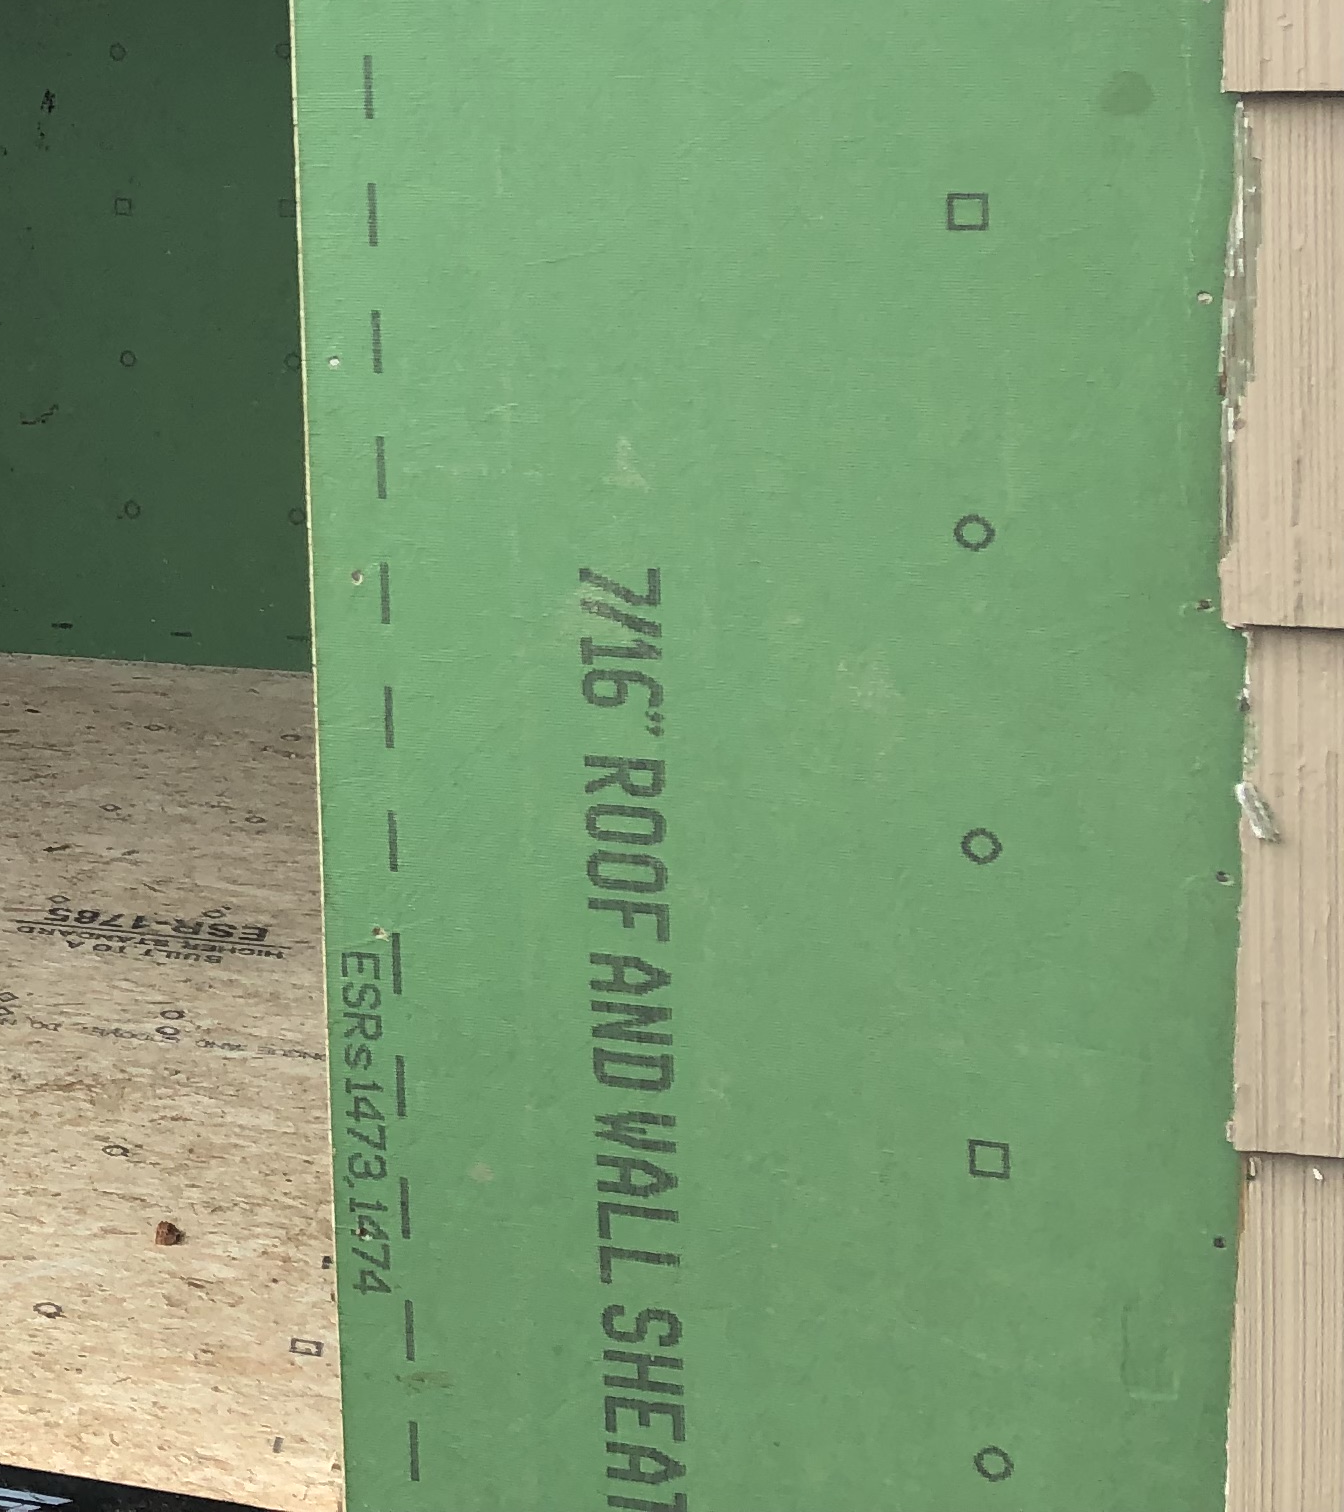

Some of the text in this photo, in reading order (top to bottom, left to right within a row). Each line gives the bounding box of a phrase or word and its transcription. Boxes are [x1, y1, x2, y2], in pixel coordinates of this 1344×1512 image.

[584, 753, 671, 943] ROOF
[43, 907, 268, 941] ESR-1785
[15, 925, 284, 960] HIGHER STANDARD
[92, 944, 127, 955] TO
[139, 949, 223, 964] BUILT
[588, 951, 675, 1092] AND
[593, 1110, 680, 1286] WALL
